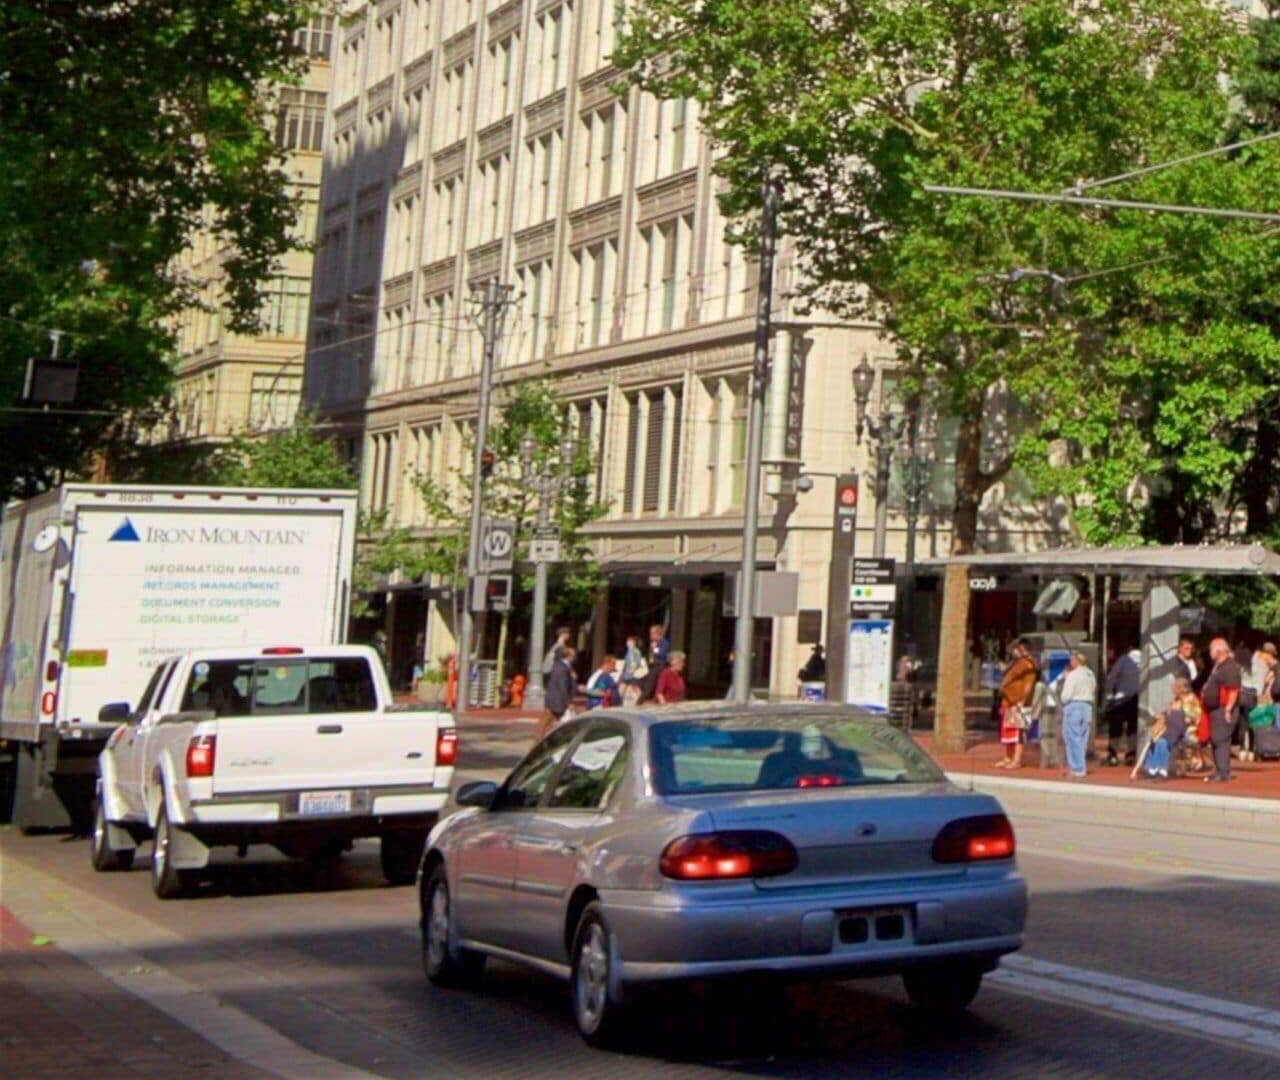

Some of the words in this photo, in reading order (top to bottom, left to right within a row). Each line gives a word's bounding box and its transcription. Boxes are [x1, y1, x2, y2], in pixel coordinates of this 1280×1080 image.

[146, 526, 195, 544] IRON
[199, 527, 305, 545] MOUNTAIN
[490, 535, 507, 551] W
[145, 564, 234, 574] INFORMATION
[239, 565, 300, 575] MANAGED
[143, 581, 196, 590] RECORDS
[201, 581, 281, 590] MANAGEMENT
[142, 598, 206, 608] DOCUMENT
[208, 599, 281, 608] CONVERSION
[140, 615, 182, 624] DIGITAL
[187, 615, 240, 624] STORAGE
